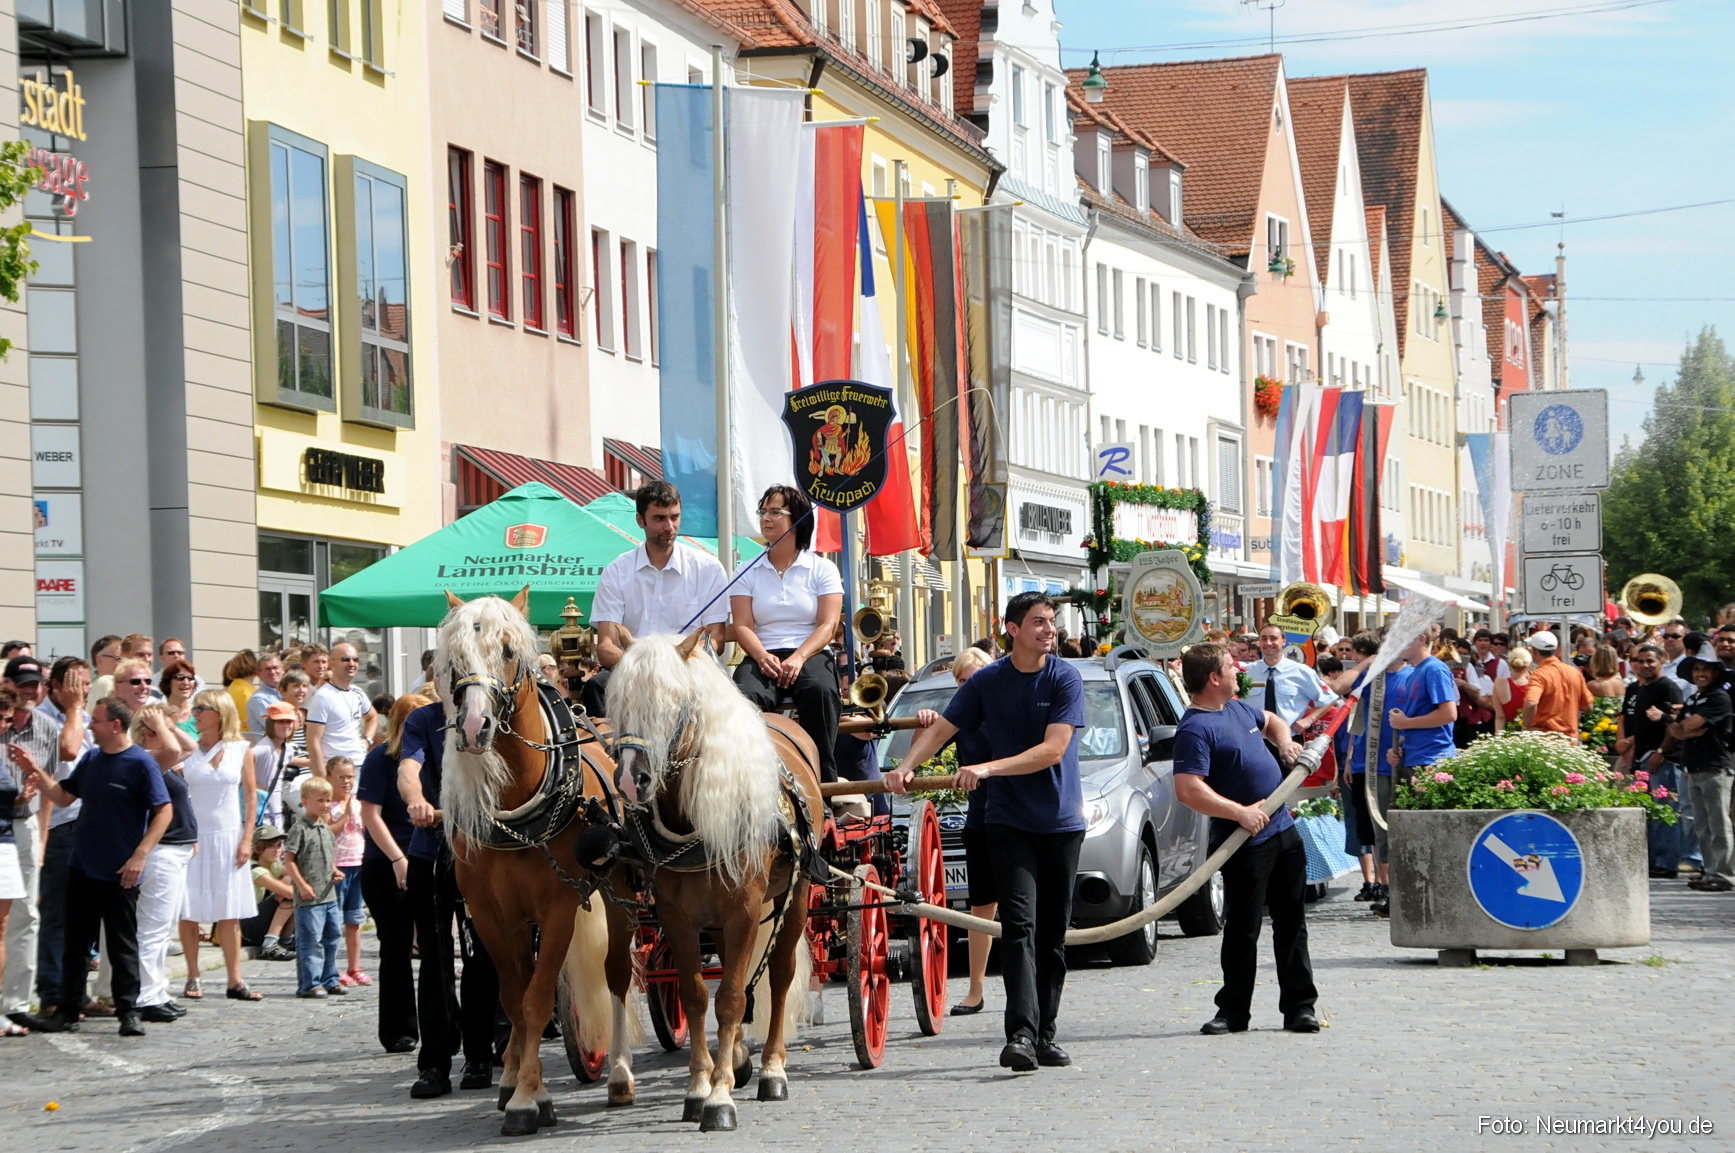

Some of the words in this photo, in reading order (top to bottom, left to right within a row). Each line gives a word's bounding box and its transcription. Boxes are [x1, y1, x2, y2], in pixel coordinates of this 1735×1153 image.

[790, 389, 840, 412] Freiwillige
[841, 386, 888, 409] Feuerwehr
[34, 451, 74, 462] WEBER
[306, 447, 345, 488] GERRY
[344, 453, 385, 494] WEBER
[1536, 464, 1584, 481] ZONE
[808, 478, 876, 507] Kruppach
[1525, 502, 1596, 515] Lieferverkehr
[1575, 518, 1582, 529] h
[51, 539, 63, 547] TV
[1552, 534, 1570, 545] frei
[464, 553, 584, 565] Neumarkter
[1139, 557, 1153, 566] 125
[1153, 555, 1179, 567] Jahre
[437, 563, 604, 578] Lammsbräu
[1240, 585, 1273, 593] Klostergasse
[1551, 595, 1575, 607] frei
